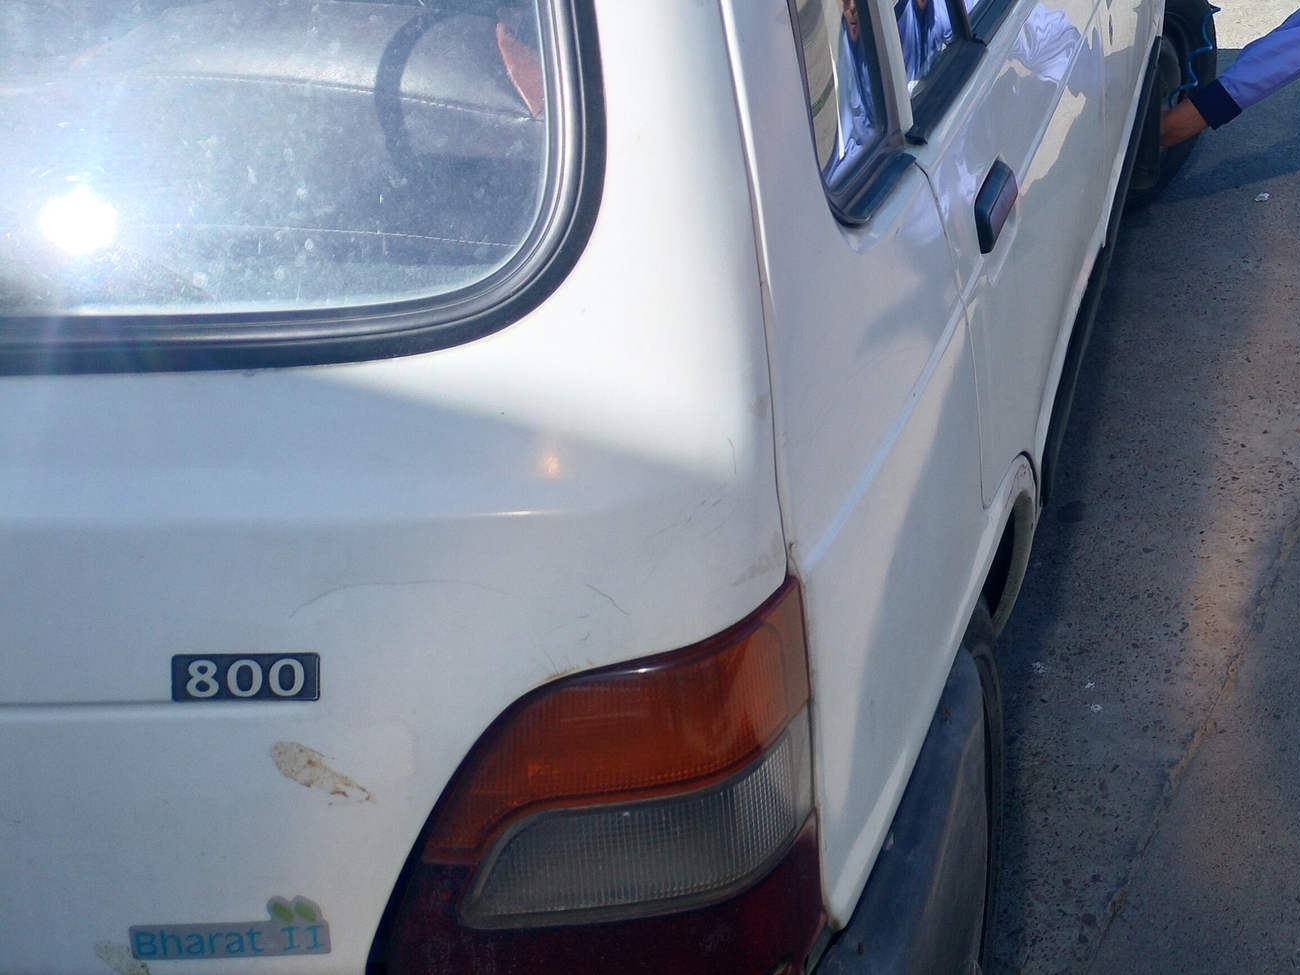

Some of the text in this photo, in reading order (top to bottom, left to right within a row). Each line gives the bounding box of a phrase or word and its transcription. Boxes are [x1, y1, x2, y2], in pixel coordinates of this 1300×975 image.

[186, 658, 305, 698] 800
[135, 925, 324, 959] Bharat II
